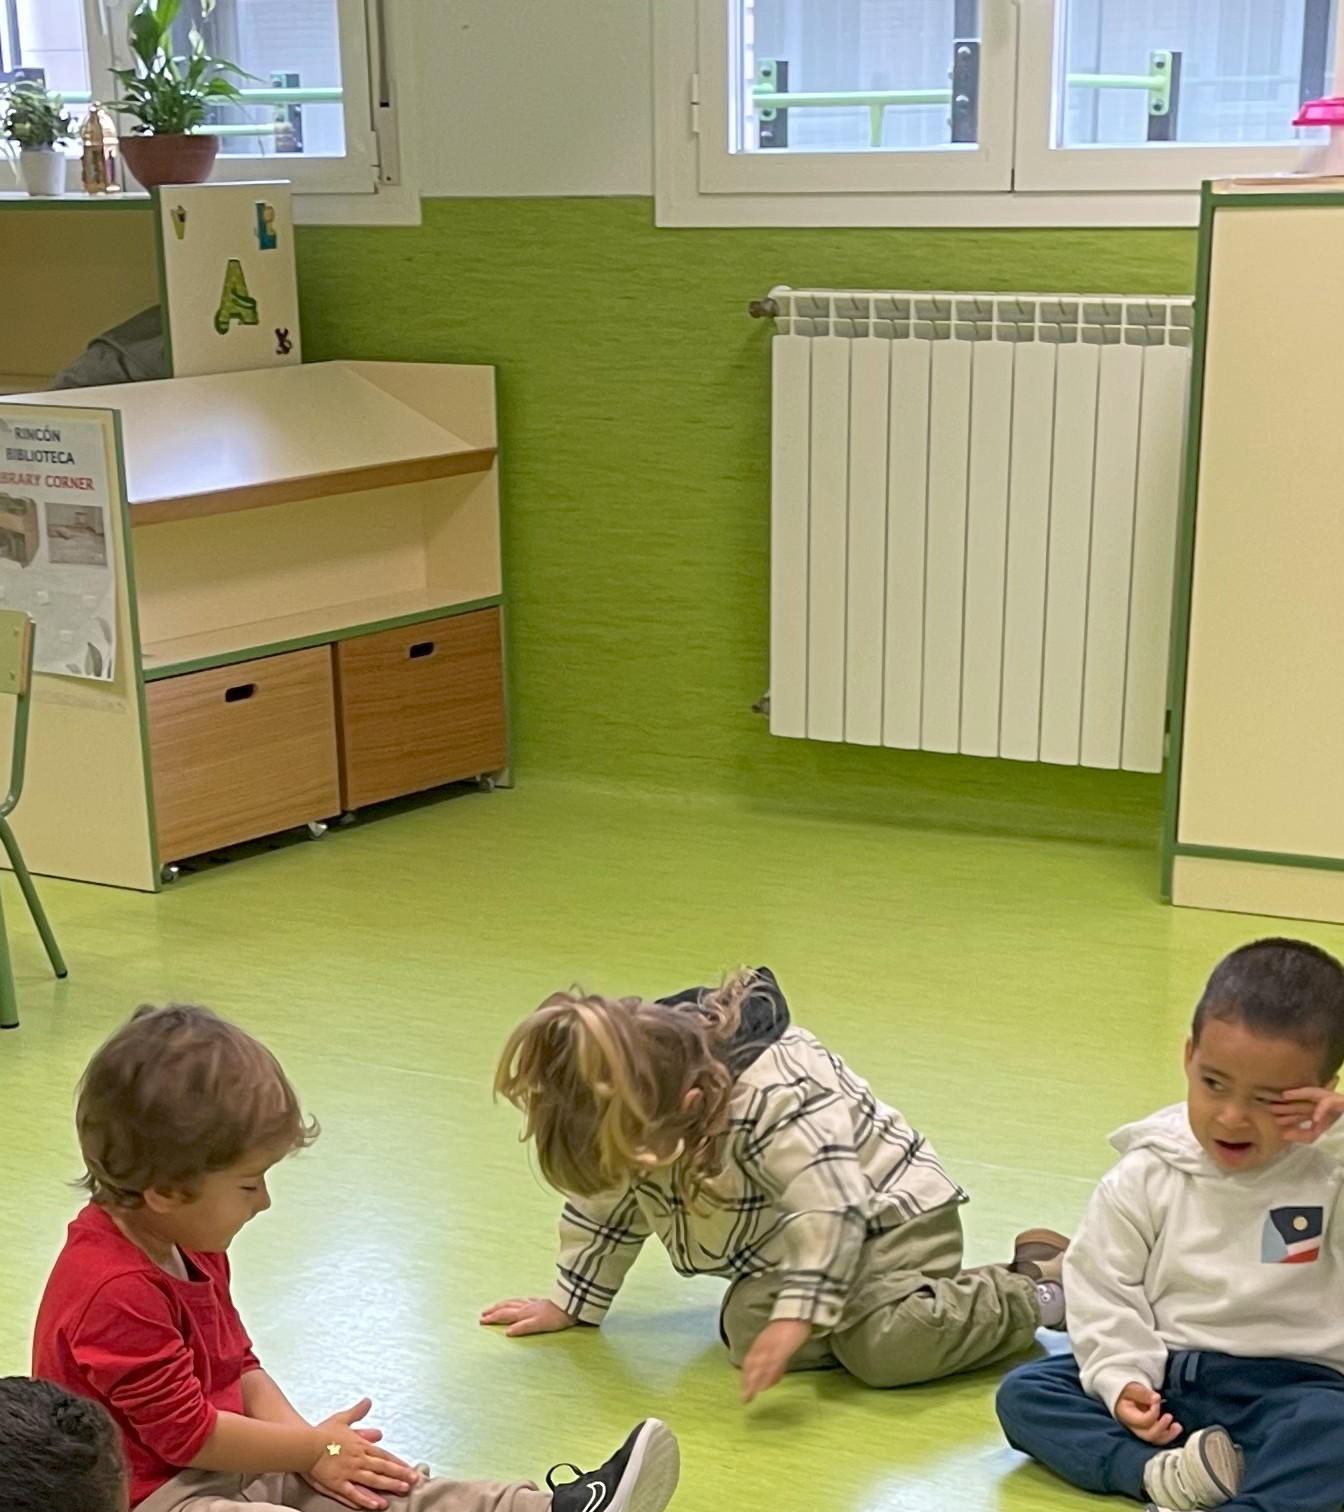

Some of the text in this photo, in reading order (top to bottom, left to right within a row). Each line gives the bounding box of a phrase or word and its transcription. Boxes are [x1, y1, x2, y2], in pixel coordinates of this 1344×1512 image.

[14, 424, 61, 443] RINCÓN
[5, 447, 76, 465] BIBLIOTECA
[44, 474, 95, 490] CORNER
